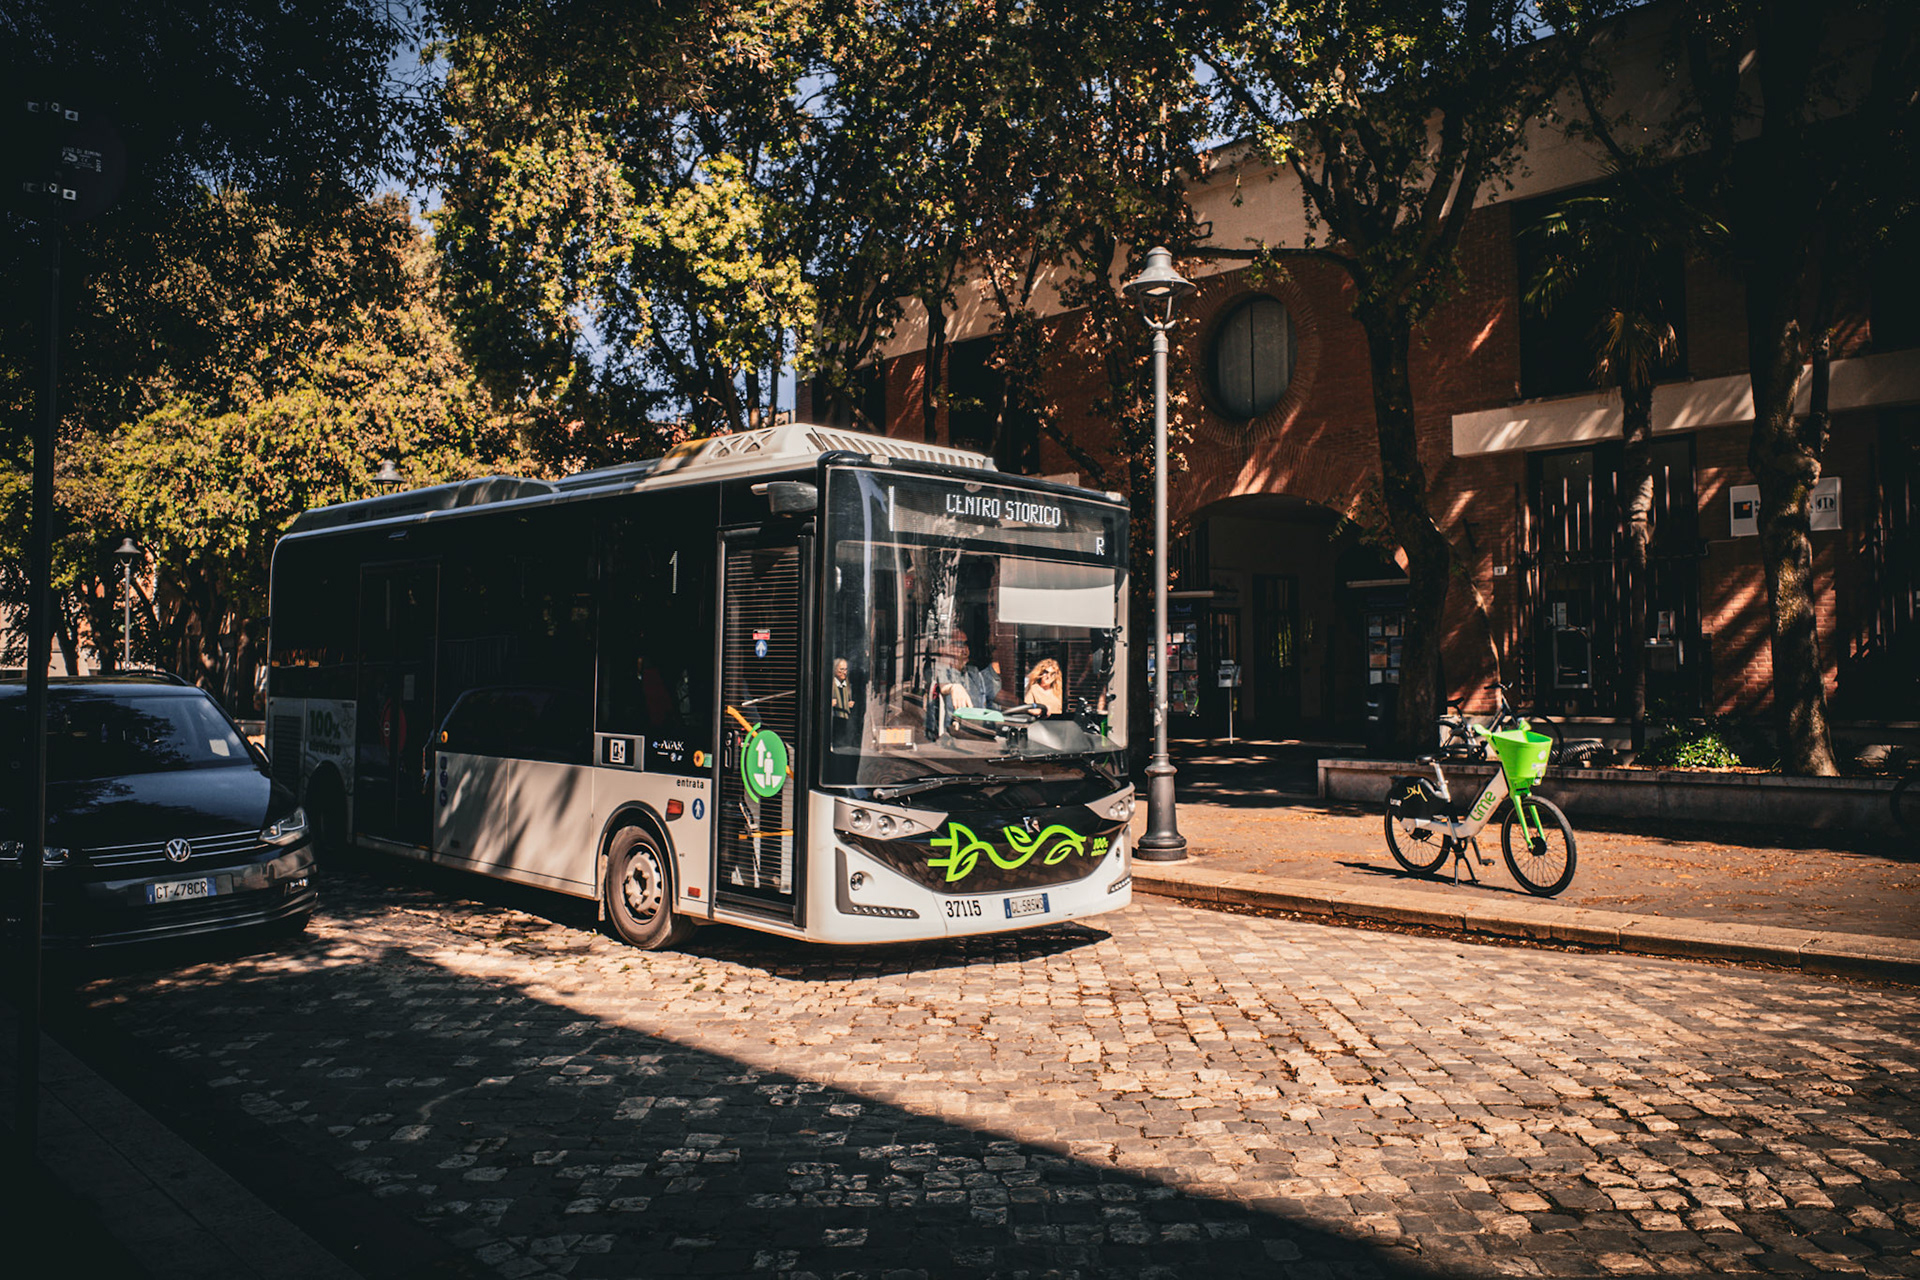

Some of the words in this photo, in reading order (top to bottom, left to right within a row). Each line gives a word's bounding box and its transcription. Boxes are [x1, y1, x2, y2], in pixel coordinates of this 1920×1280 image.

[946, 493, 1000, 519] CENTRO
[1005, 500, 1061, 526] STORICO
[1095, 536, 1105, 556] R
[668, 550, 678, 594] 1
[310, 710, 341, 739] 100%
[676, 779, 704, 789] entrata
[945, 900, 982, 918] 37115
